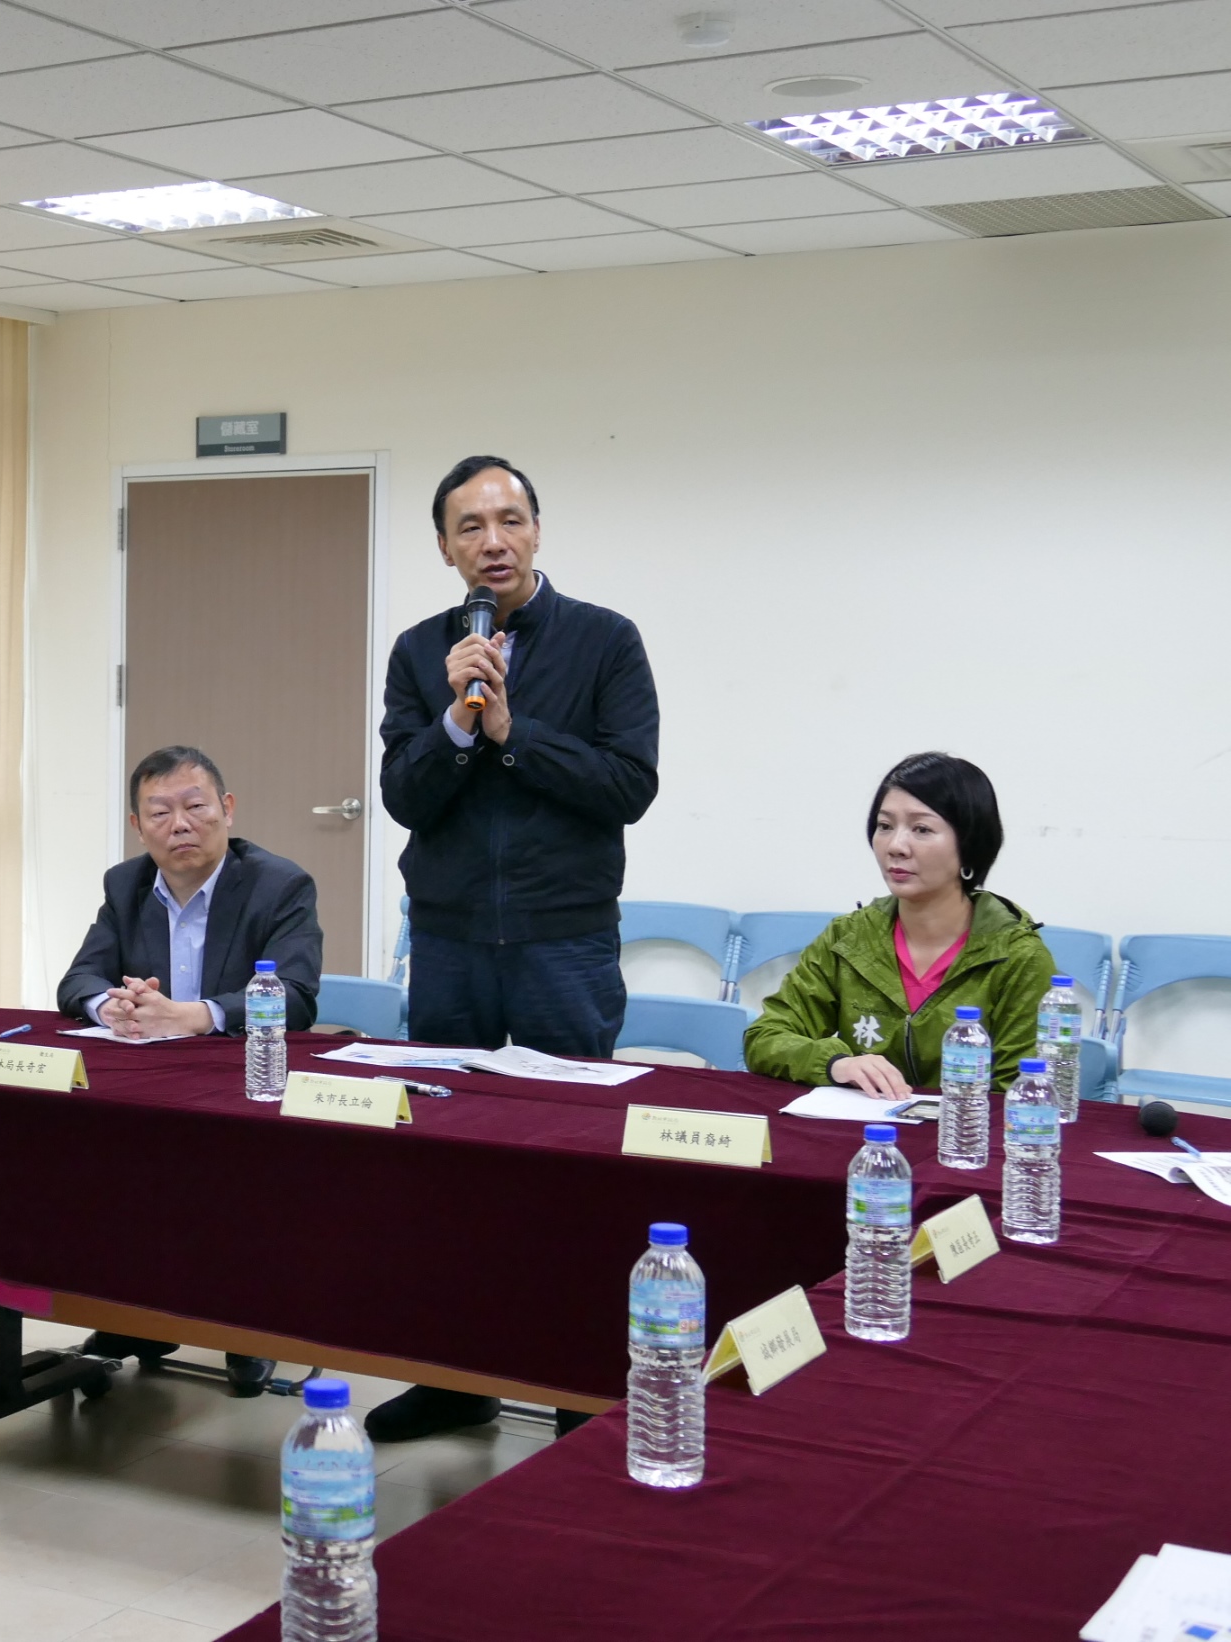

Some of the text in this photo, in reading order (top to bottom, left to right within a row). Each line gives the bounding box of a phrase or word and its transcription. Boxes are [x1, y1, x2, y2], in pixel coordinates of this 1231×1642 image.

[852, 1014, 884, 1048] 林
[313, 1091, 374, 1109] 朱市長立倫
[659, 1129, 732, 1148] 林議員裔綺
